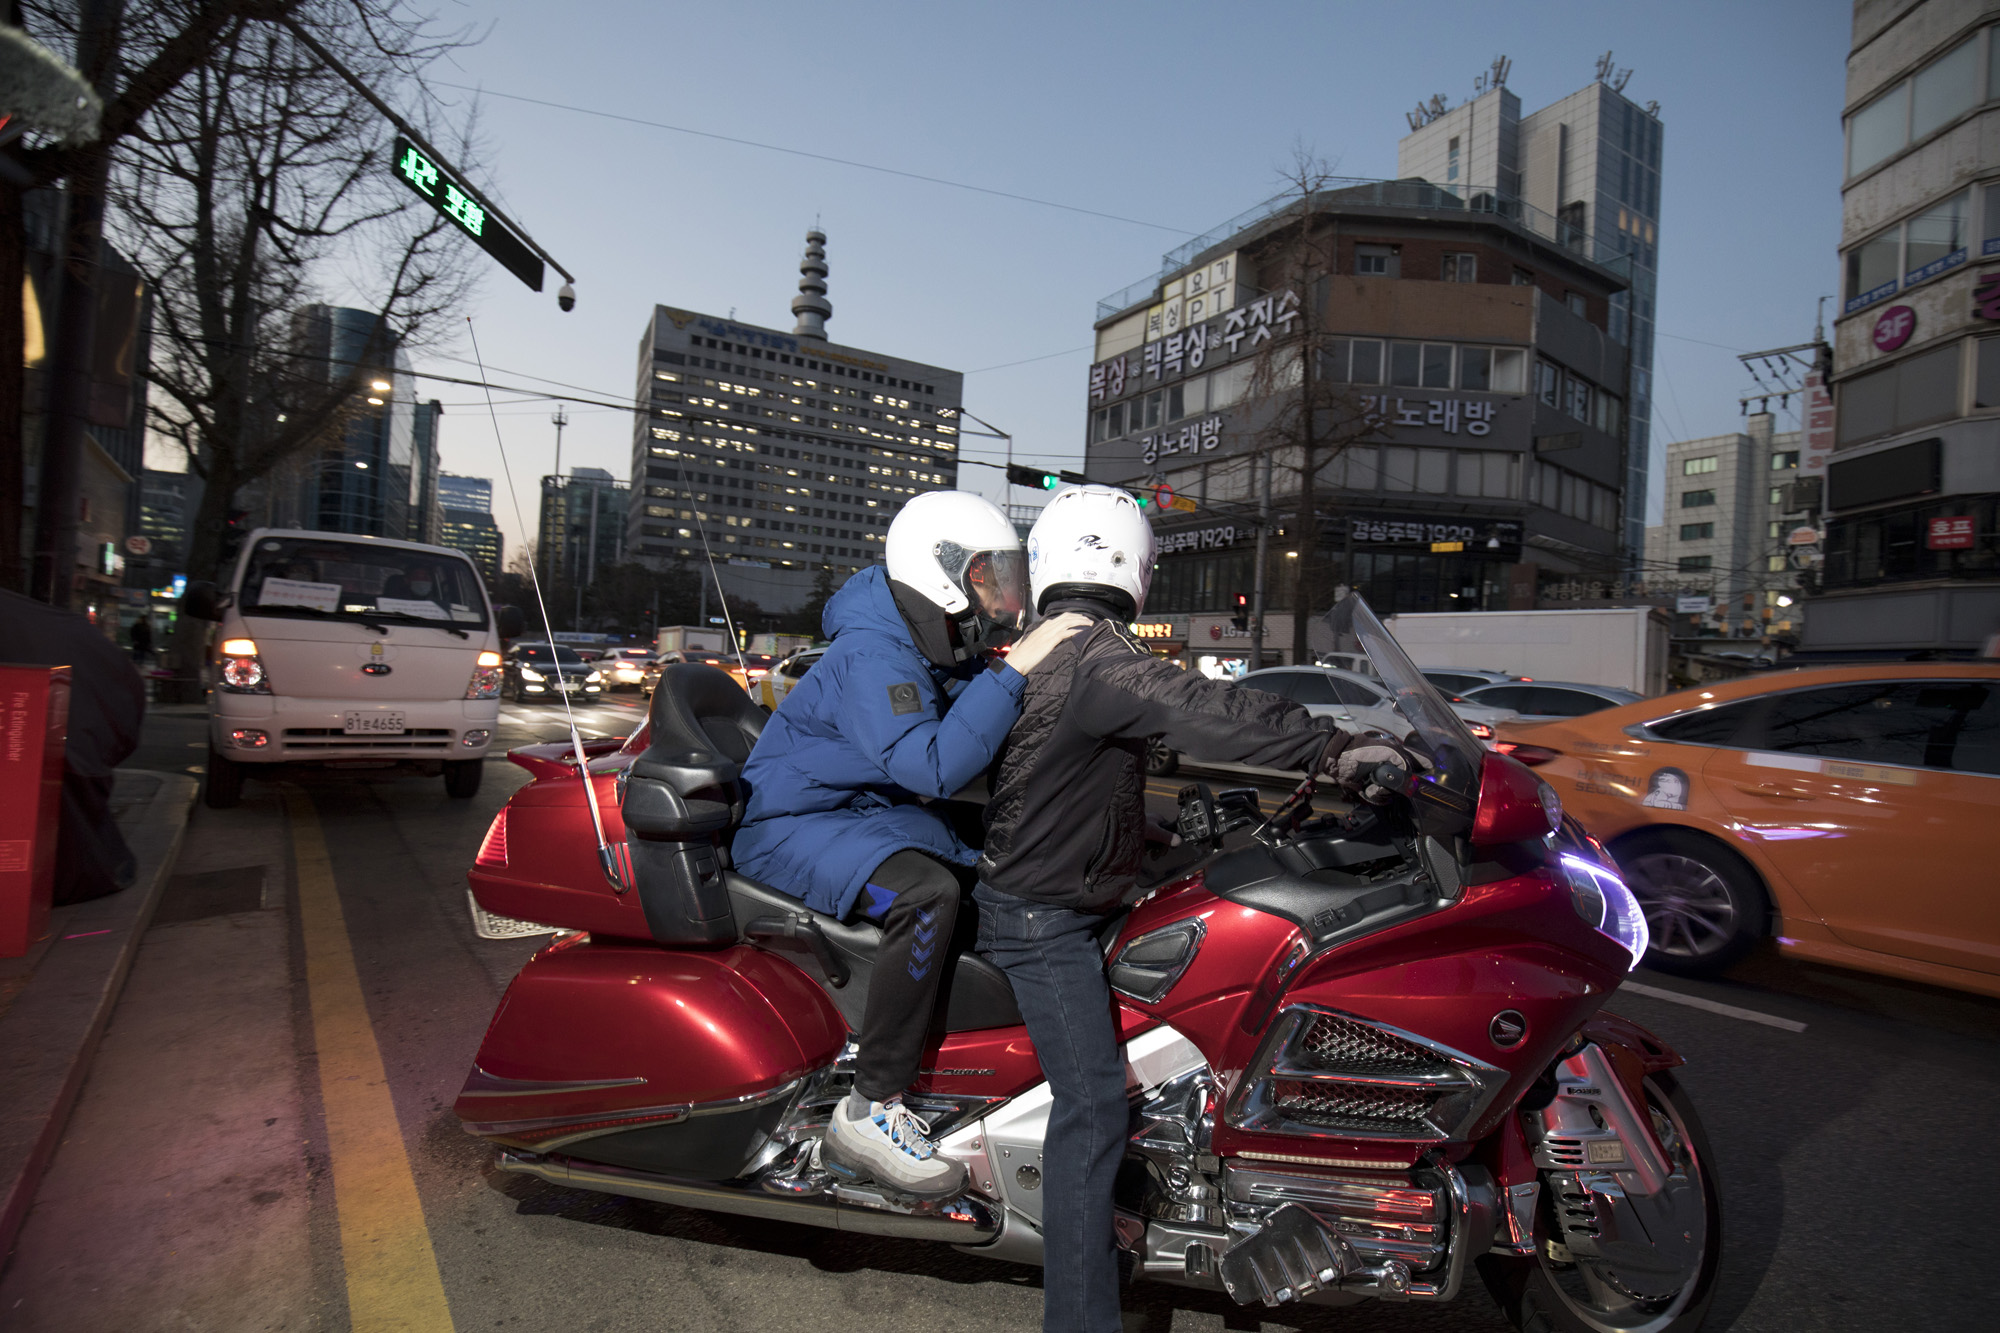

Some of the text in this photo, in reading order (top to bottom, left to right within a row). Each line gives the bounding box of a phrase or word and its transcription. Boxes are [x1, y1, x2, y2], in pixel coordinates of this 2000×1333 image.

[1191, 259, 1229, 293] 요가
[1150, 288, 1226, 333] 복싱 PT
[1876, 312, 1911, 344] 3F
[1090, 290, 1300, 400] 복싱 킥복싱 주짓수
[1360, 395, 1496, 436] 킹노래방
[1141, 416, 1222, 465] 킹노래방
[1351, 519, 1475, 547] 경성주막1929
[1930, 519, 1973, 537] 호프
[7, 692, 30, 762] Fire Extinguisher
